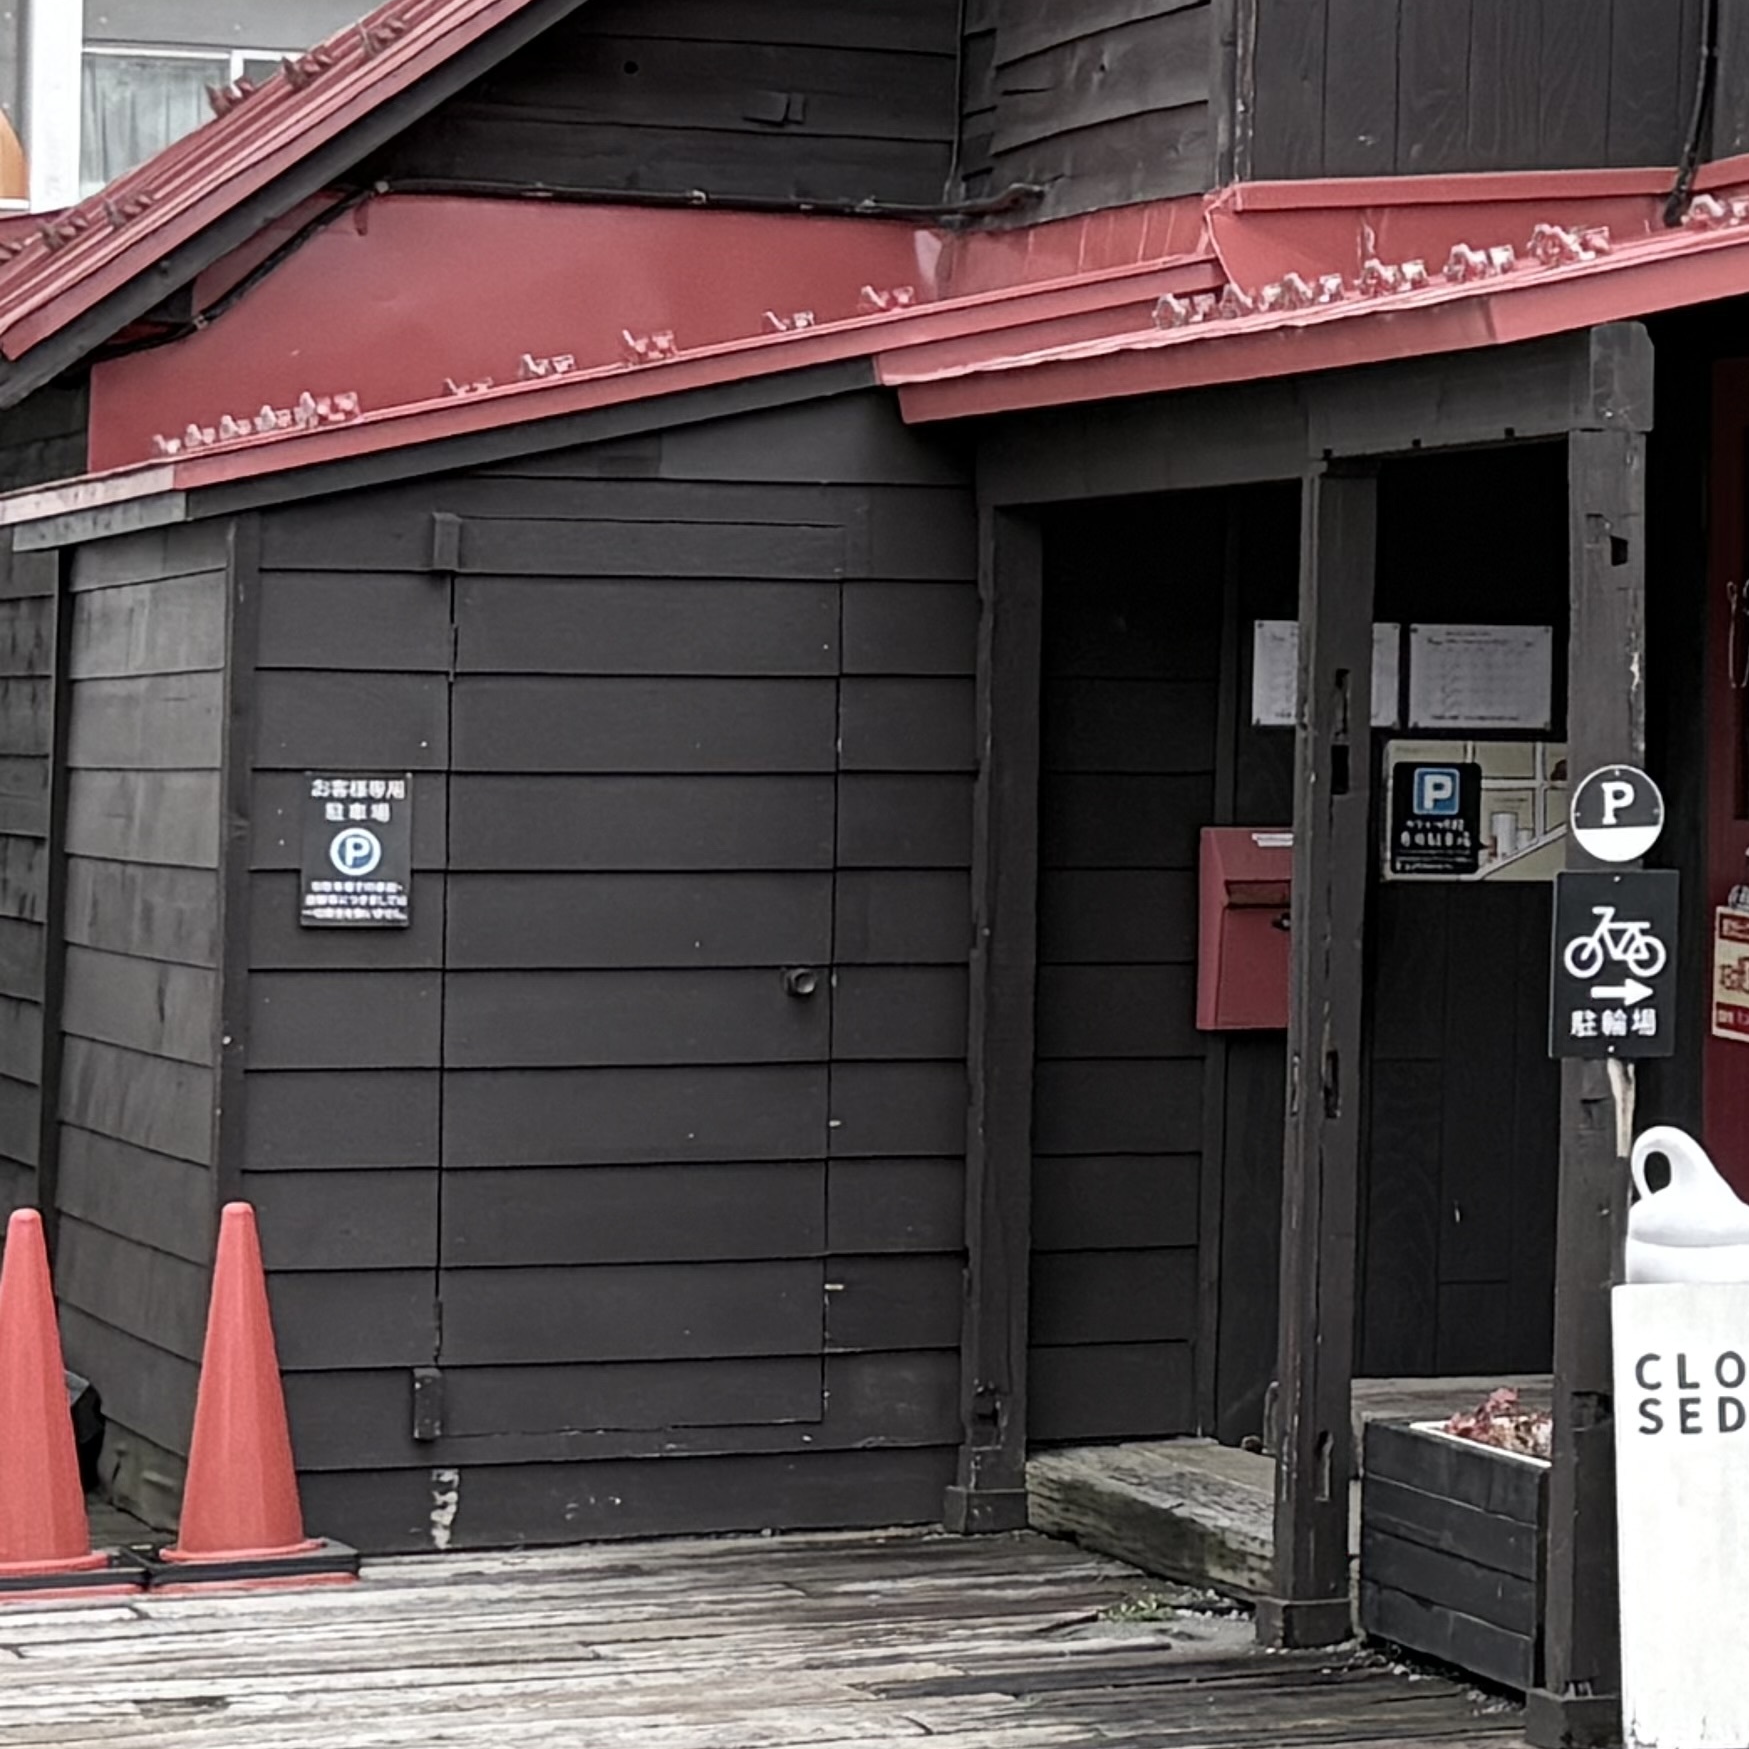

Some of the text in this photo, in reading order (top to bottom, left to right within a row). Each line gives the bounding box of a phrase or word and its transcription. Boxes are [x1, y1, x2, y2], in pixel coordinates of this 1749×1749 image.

[1423, 774, 1453, 810] P
[1601, 781, 1635, 825] P
[345, 837, 371, 868] P
[1570, 1007, 1658, 1038] 駐輪場
[1634, 1350, 1747, 1391] CLO
[1638, 1396, 1747, 1436] SED
